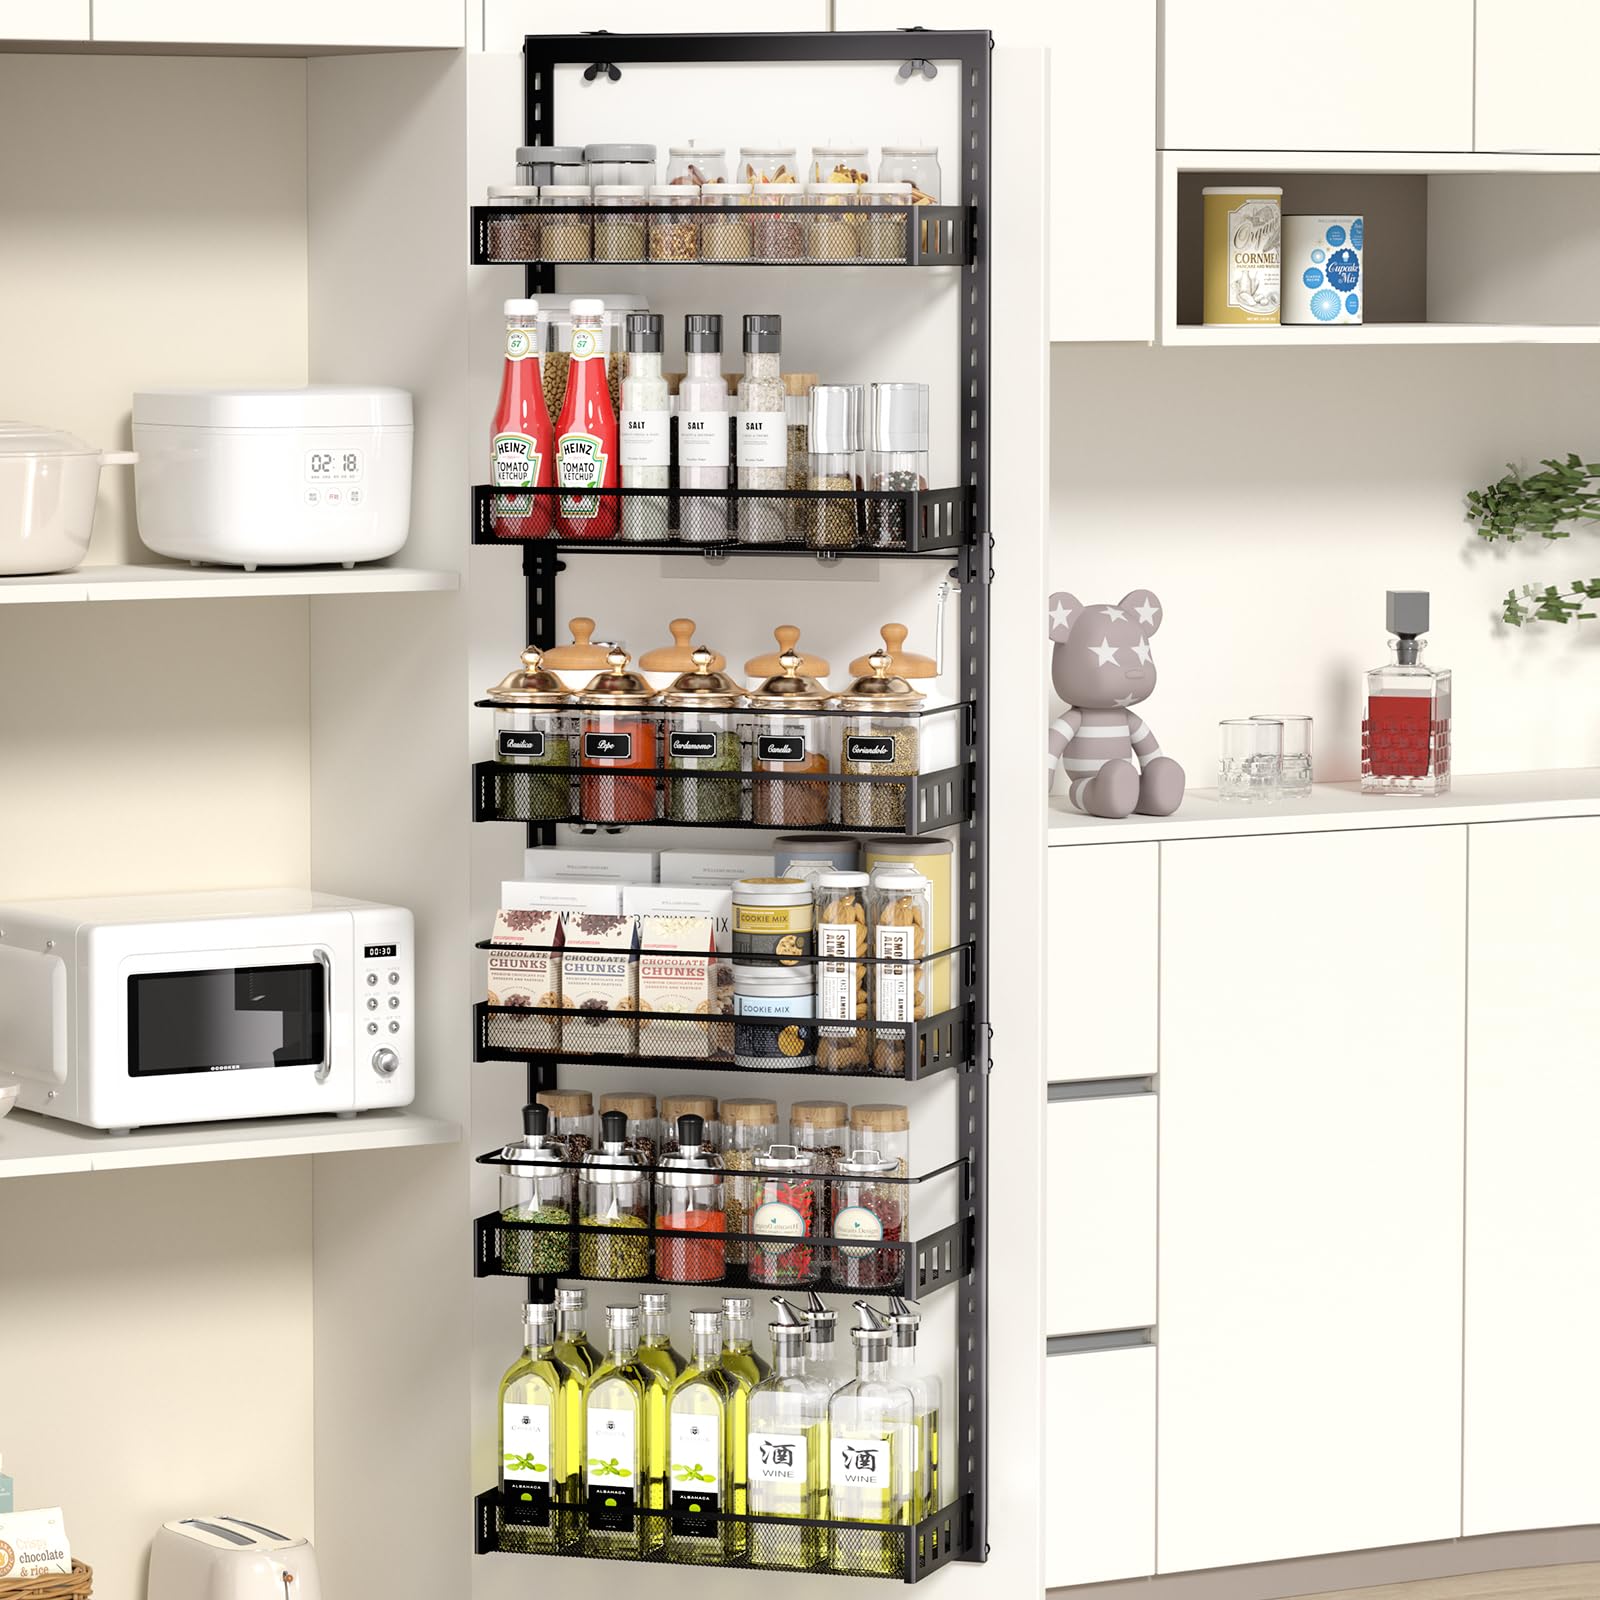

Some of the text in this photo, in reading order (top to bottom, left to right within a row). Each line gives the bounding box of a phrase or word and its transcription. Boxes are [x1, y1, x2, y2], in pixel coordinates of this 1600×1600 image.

[1328, 262, 1358, 274] Cupcake
[1341, 272, 1356, 283] Mix
[628, 421, 645, 429] SALT
[498, 442, 526, 454] HEINZ
[564, 443, 592, 455] HEINZ
[498, 462, 528, 472] TOMATO
[563, 462, 594, 472] TOMATO
[369, 947, 391, 956] 00:30
[836, 934, 845, 973] SMOED
[894, 937, 903, 975] SMOED
[490, 959, 547, 969] CHUNKS
[564, 963, 625, 973] CHUNKS
[642, 967, 704, 976] CHUNKS
[760, 1440, 796, 1467] 酒
[842, 1446, 879, 1472] 酒
[762, 1469, 794, 1478] WINE
[845, 1474, 877, 1483] WINE
[20, 1549, 64, 1563] chocolate
[20, 1565, 48, 1577] & rice
